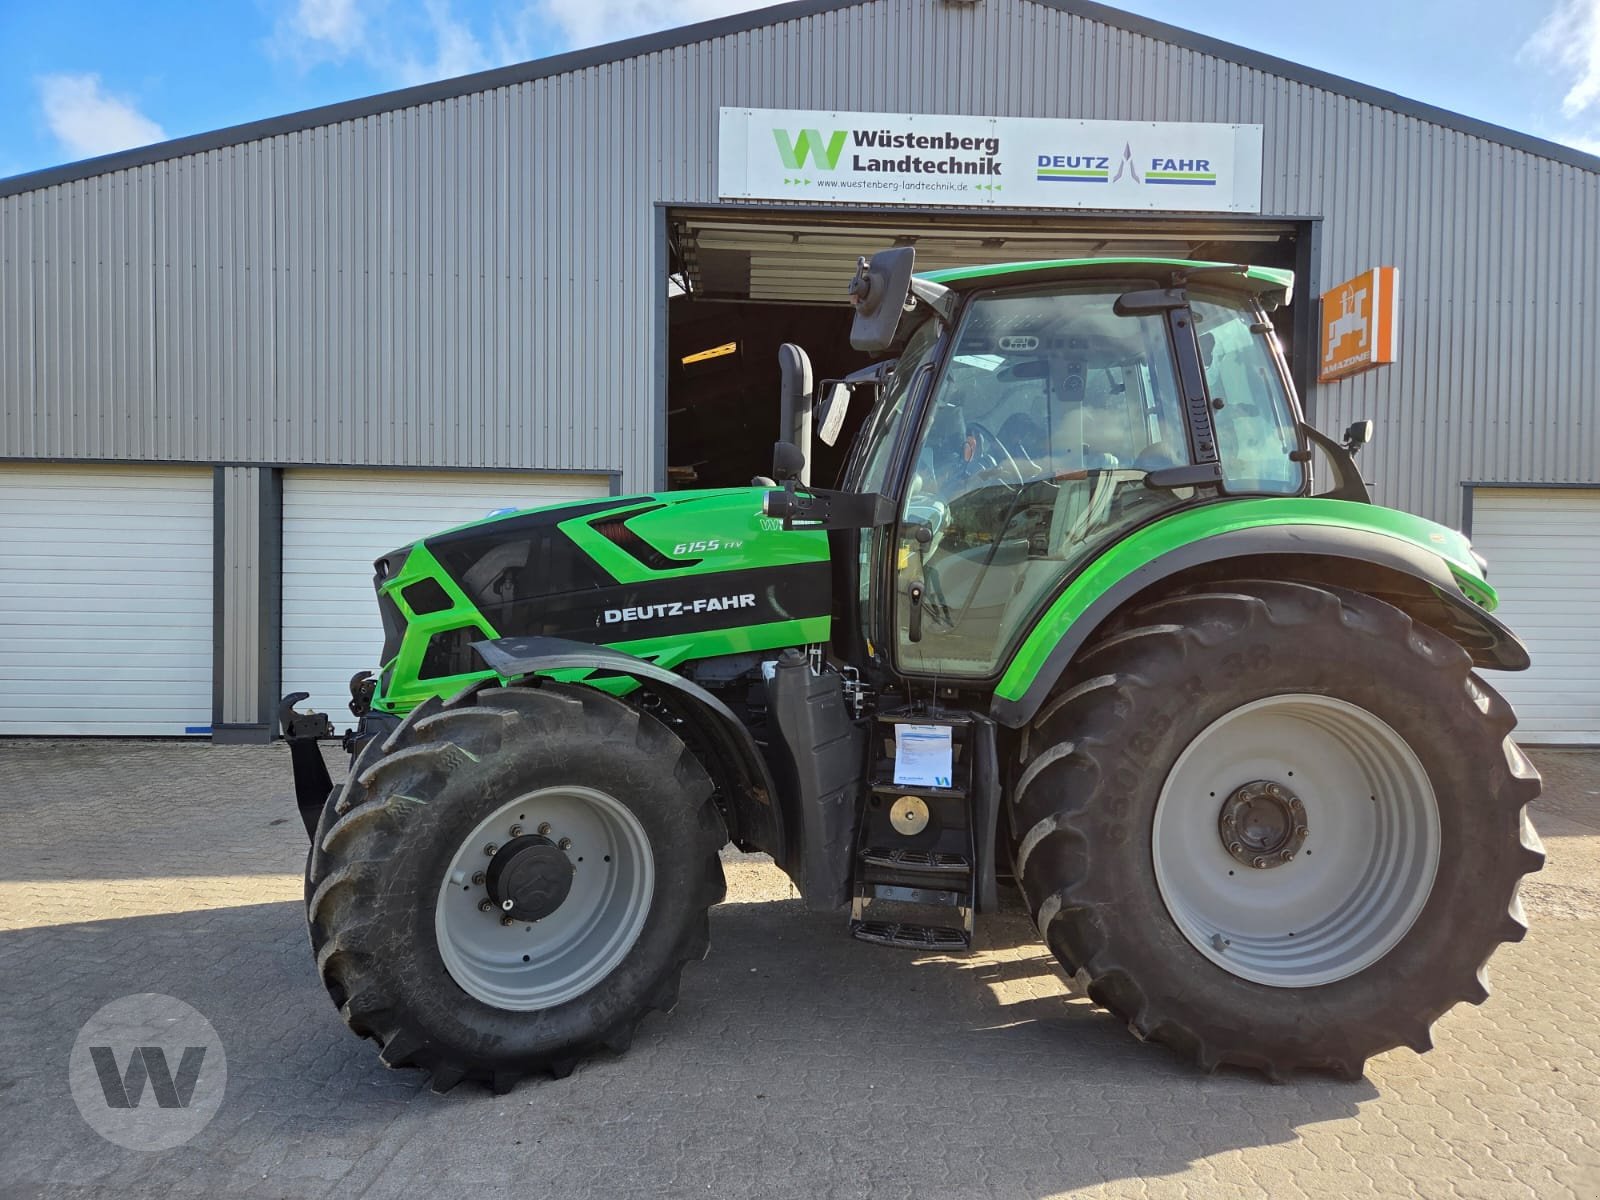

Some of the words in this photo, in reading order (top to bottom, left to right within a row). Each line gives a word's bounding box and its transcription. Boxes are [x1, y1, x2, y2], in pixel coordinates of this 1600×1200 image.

[853, 129, 1000, 156] Wüstenberg
[852, 154, 1003, 176] Landtechnik
[1037, 155, 1109, 169] DEUTZ
[1151, 158, 1210, 172] FAHR
[817, 178, 968, 192] www.wuestenberg-landtechnik.de
[1322, 350, 1370, 374] AMAZONE
[673, 540, 721, 555] 6155
[604, 593, 756, 624] DEUTZ-FAHR
